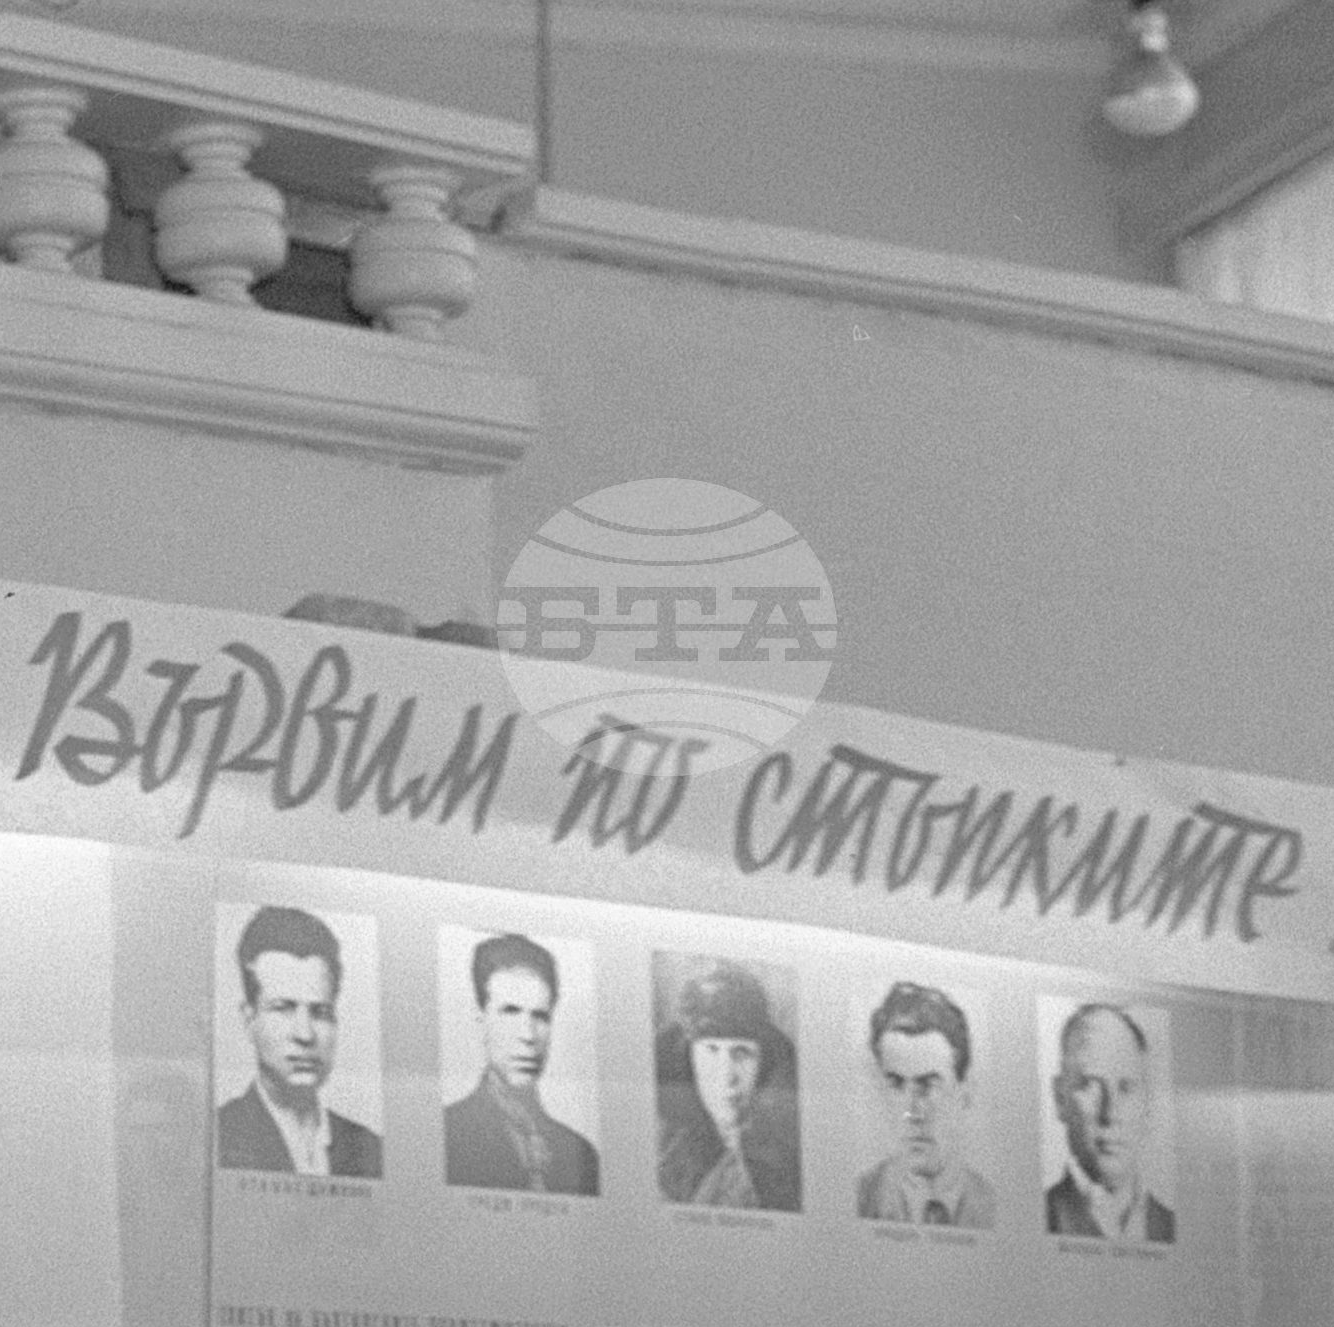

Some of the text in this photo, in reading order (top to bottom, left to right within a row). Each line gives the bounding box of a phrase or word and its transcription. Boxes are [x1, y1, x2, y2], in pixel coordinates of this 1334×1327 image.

[14, 612, 516, 838] Вървим
[551, 713, 708, 853] по
[734, 744, 1302, 942] стъпките
